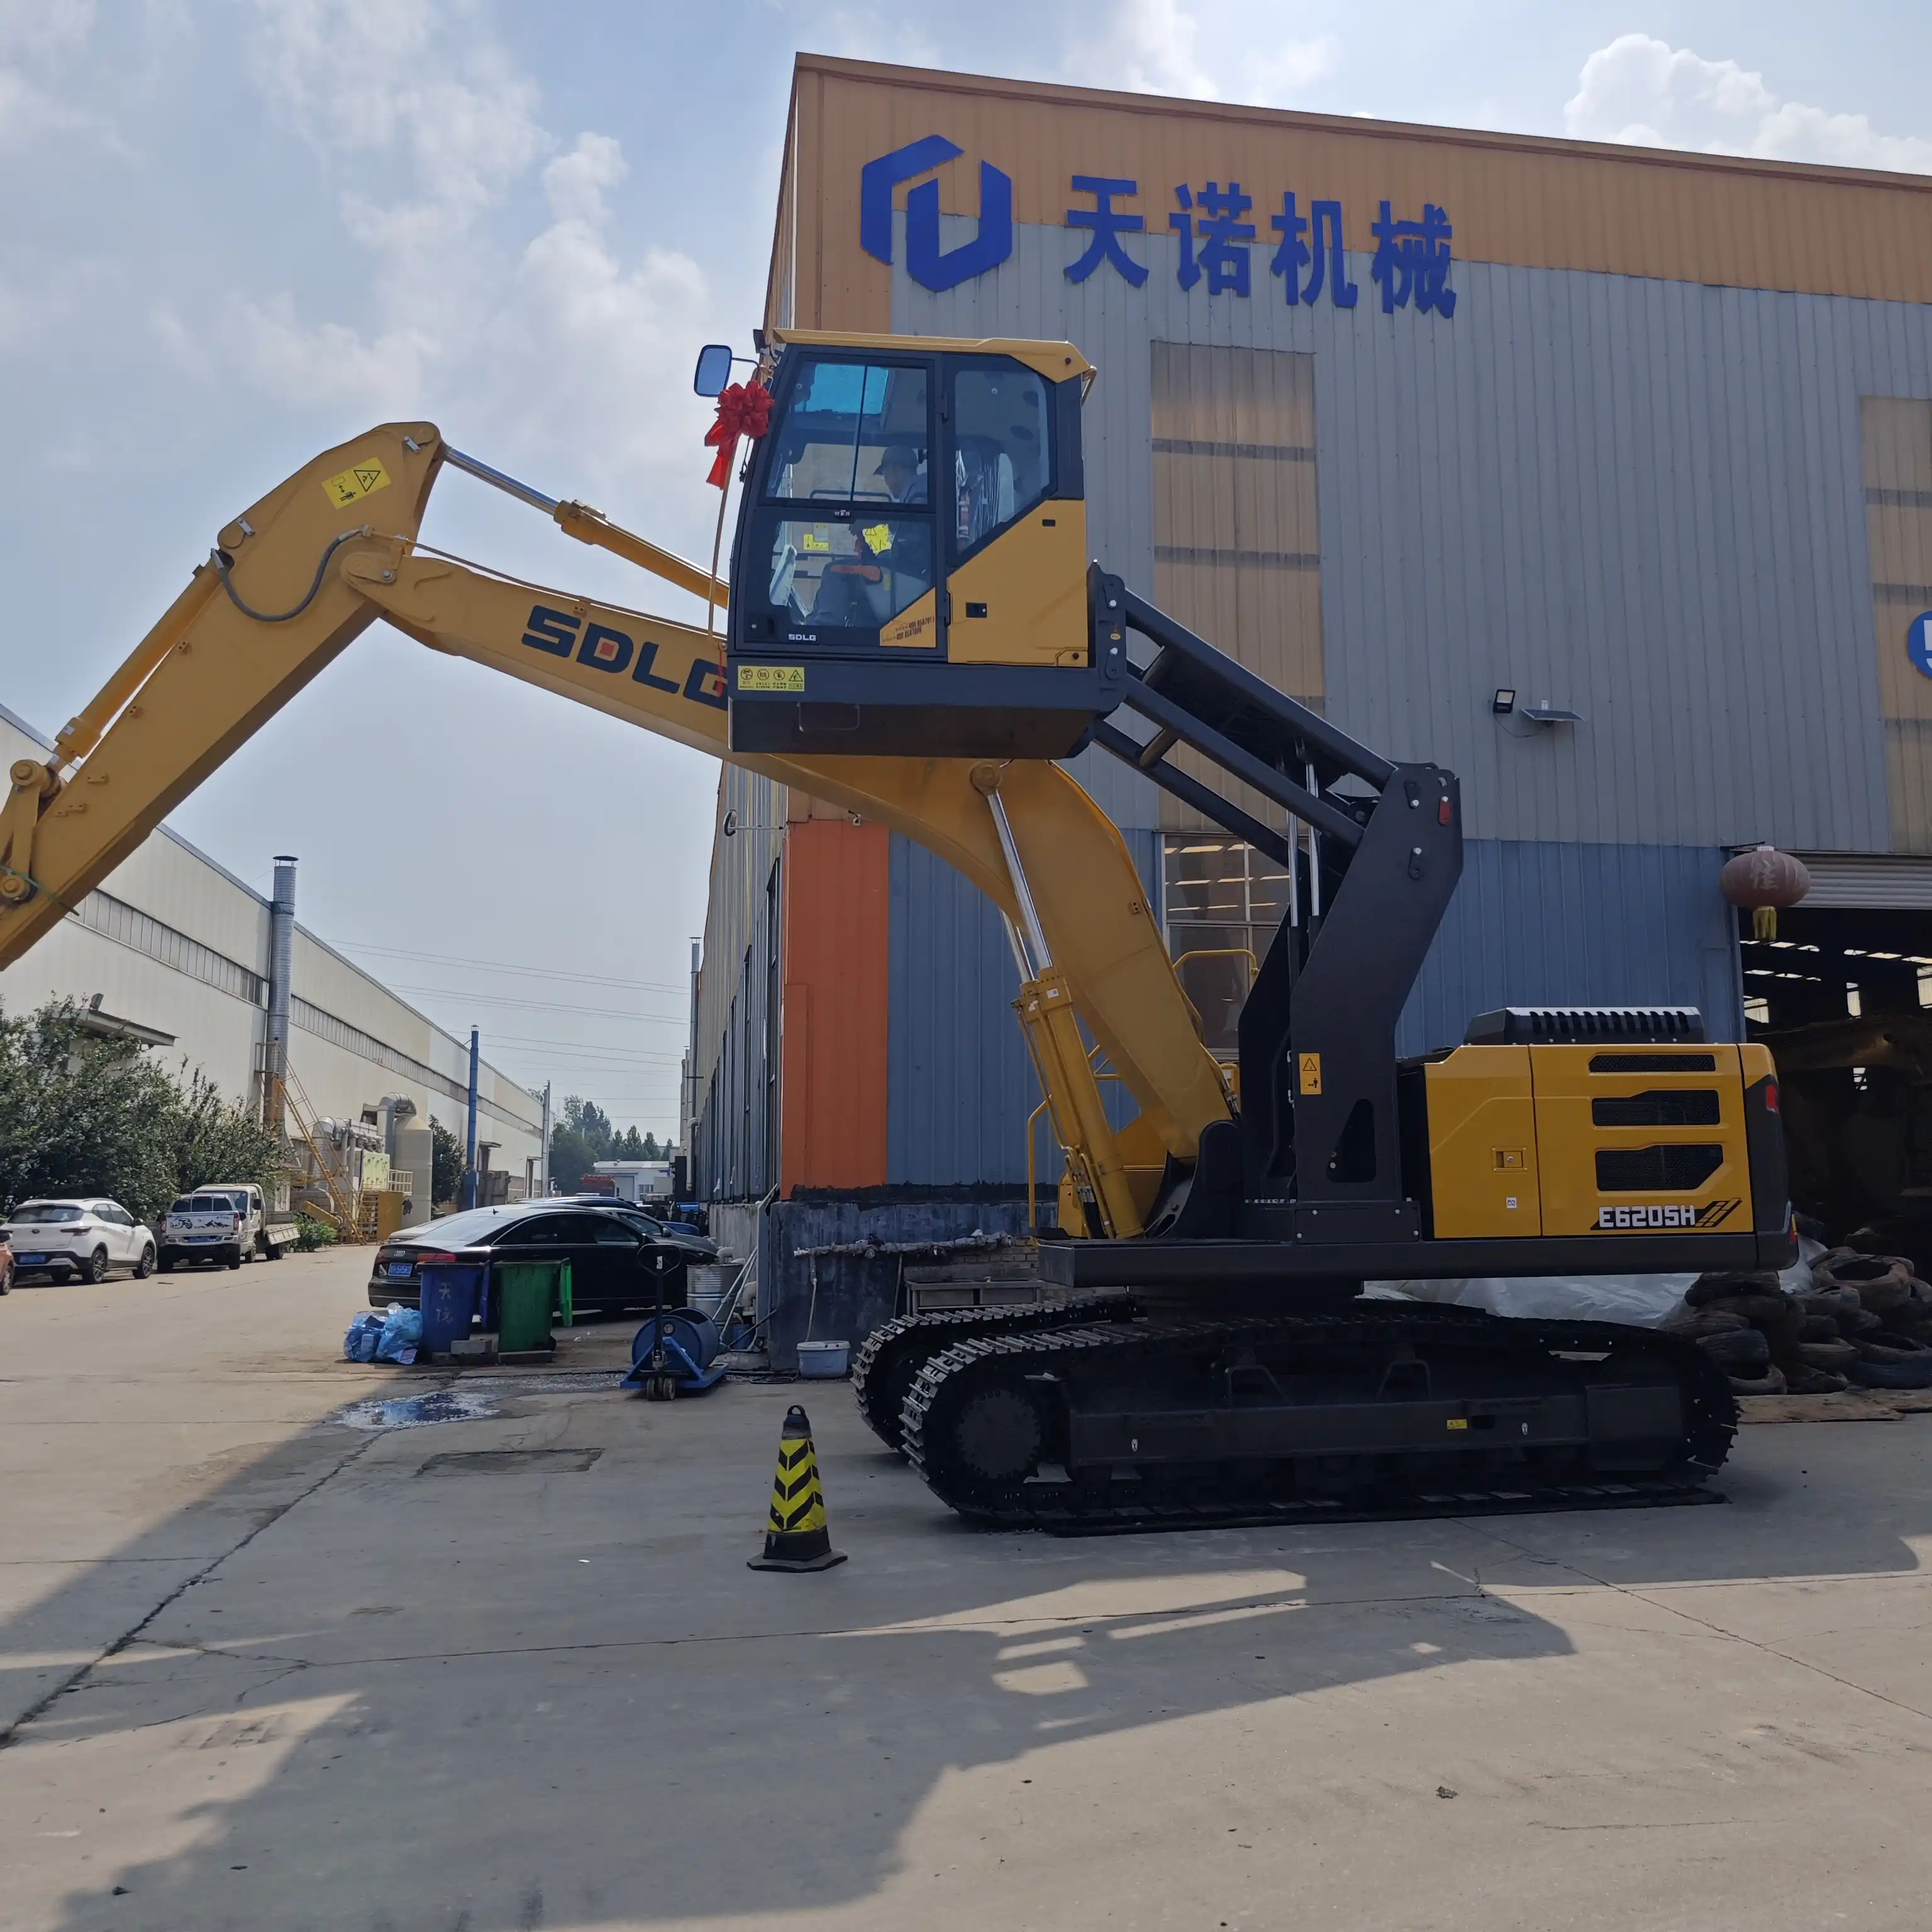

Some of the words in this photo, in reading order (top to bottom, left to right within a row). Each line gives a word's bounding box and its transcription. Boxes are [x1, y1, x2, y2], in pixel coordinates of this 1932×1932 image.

[1063, 175, 1457, 319] 天诺机械
[788, 633, 816, 641] SDLG
